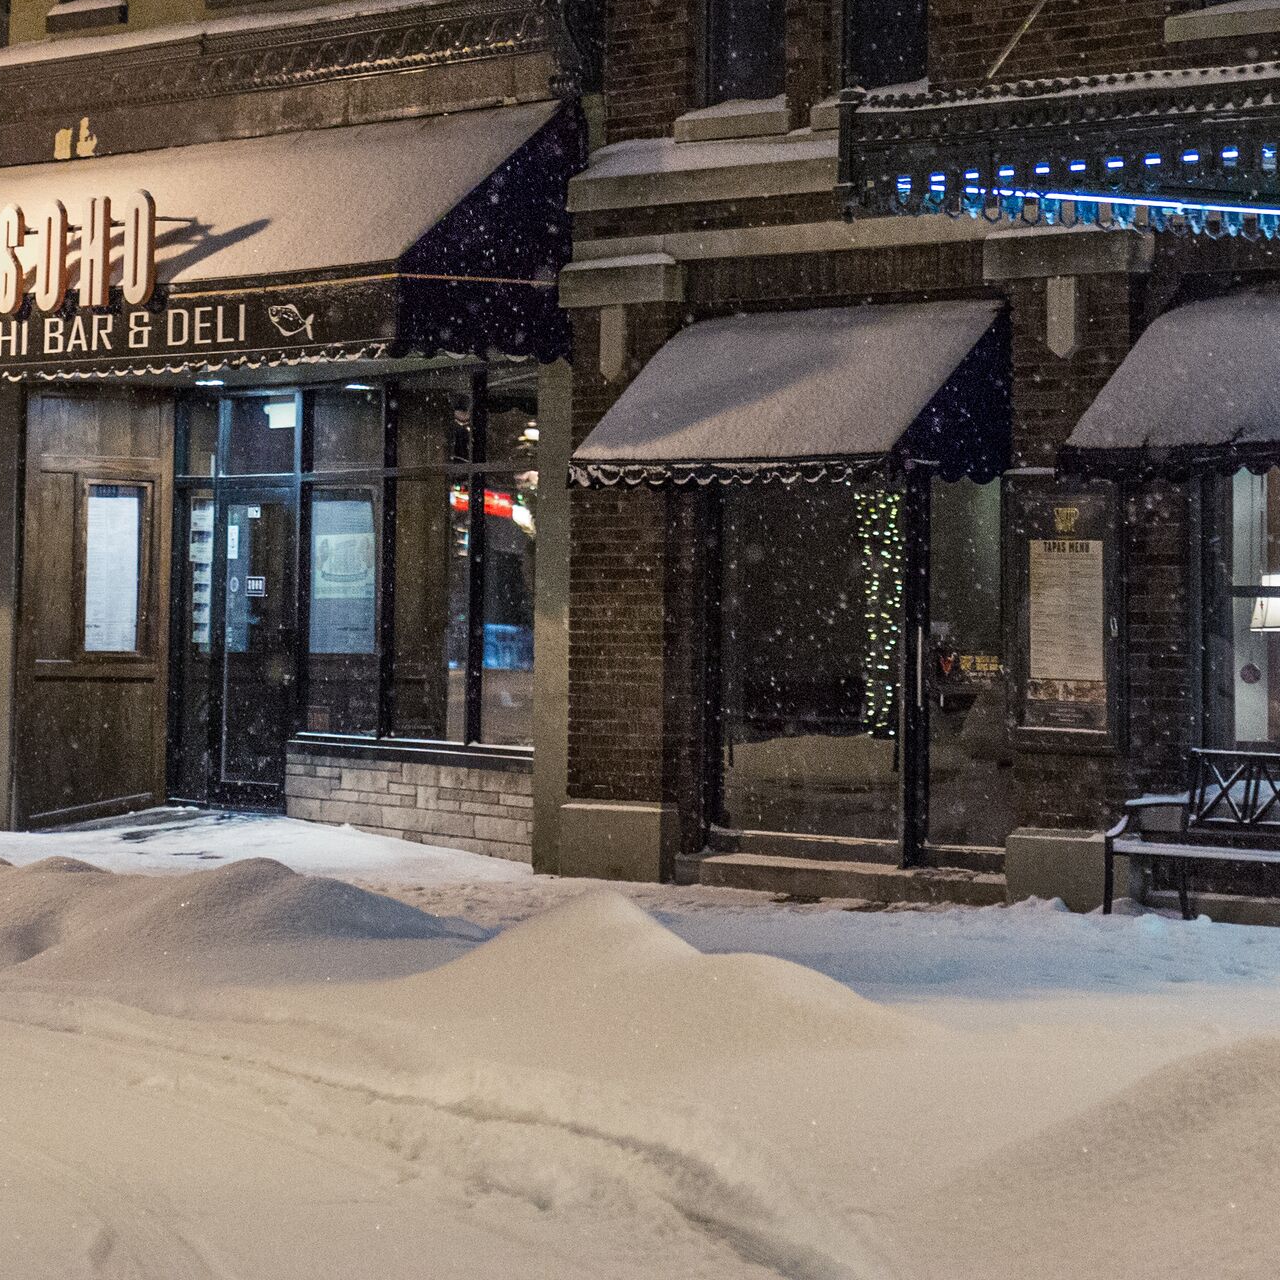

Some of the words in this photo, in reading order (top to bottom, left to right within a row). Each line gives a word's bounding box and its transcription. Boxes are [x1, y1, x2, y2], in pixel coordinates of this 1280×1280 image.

[43, 314, 113, 354] BAR
[127, 311, 153, 349] &
[166, 303, 247, 347] DELI
[1043, 541, 1066, 553] TAPAS
[1069, 542, 1090, 554] MENU
